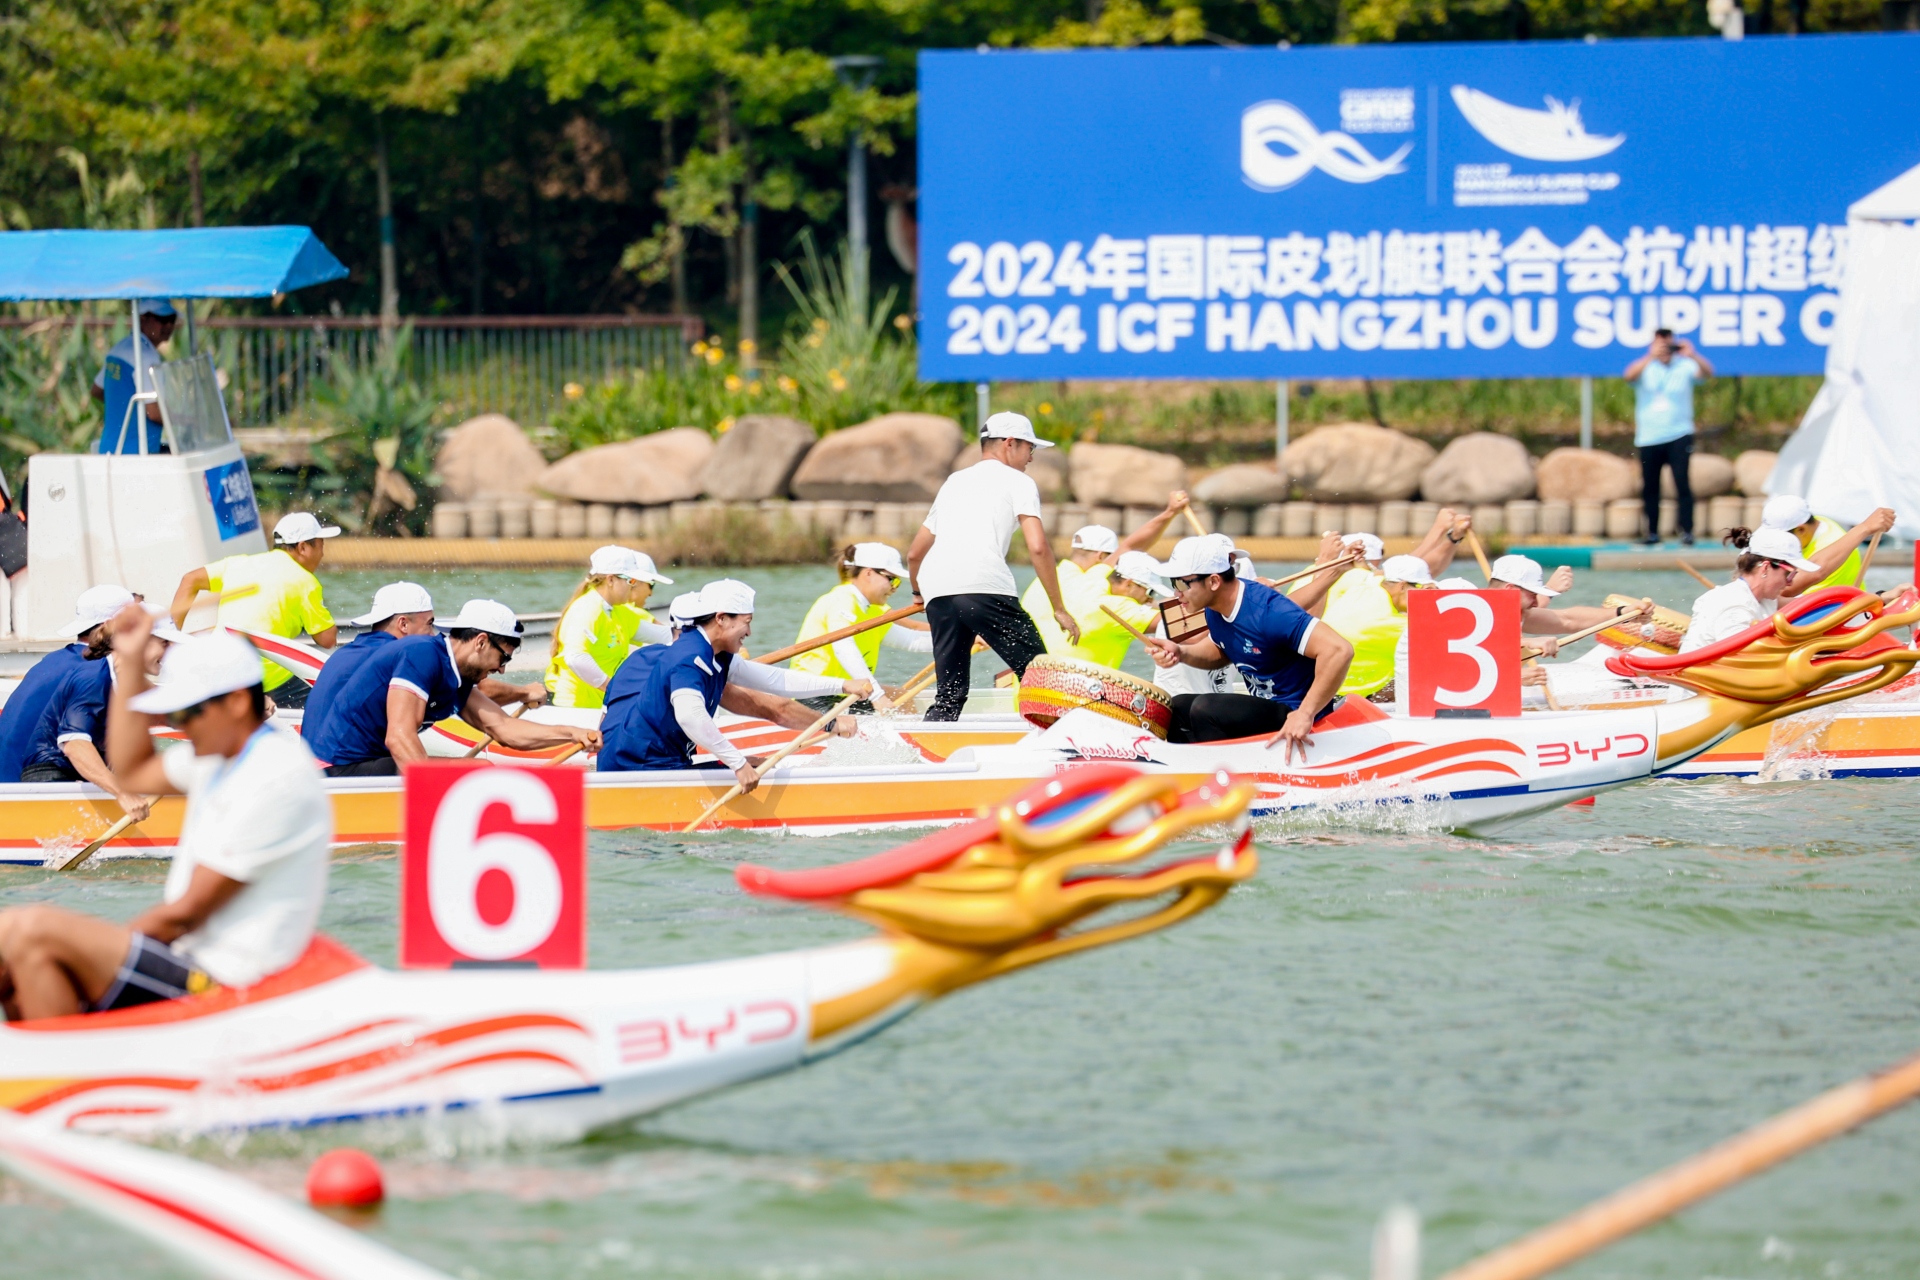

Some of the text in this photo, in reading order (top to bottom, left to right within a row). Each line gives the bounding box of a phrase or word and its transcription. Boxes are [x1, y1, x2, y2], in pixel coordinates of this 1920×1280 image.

[947, 304, 1087, 354] 2024
[1097, 302, 1196, 352] ICF
[1206, 297, 1559, 351] HANGZHOU
[1572, 293, 1787, 349] SUPER
[1433, 592, 1499, 707] 3
[1536, 733, 1649, 768] BYD
[427, 767, 563, 961] 6
[616, 1000, 798, 1064] BYD
